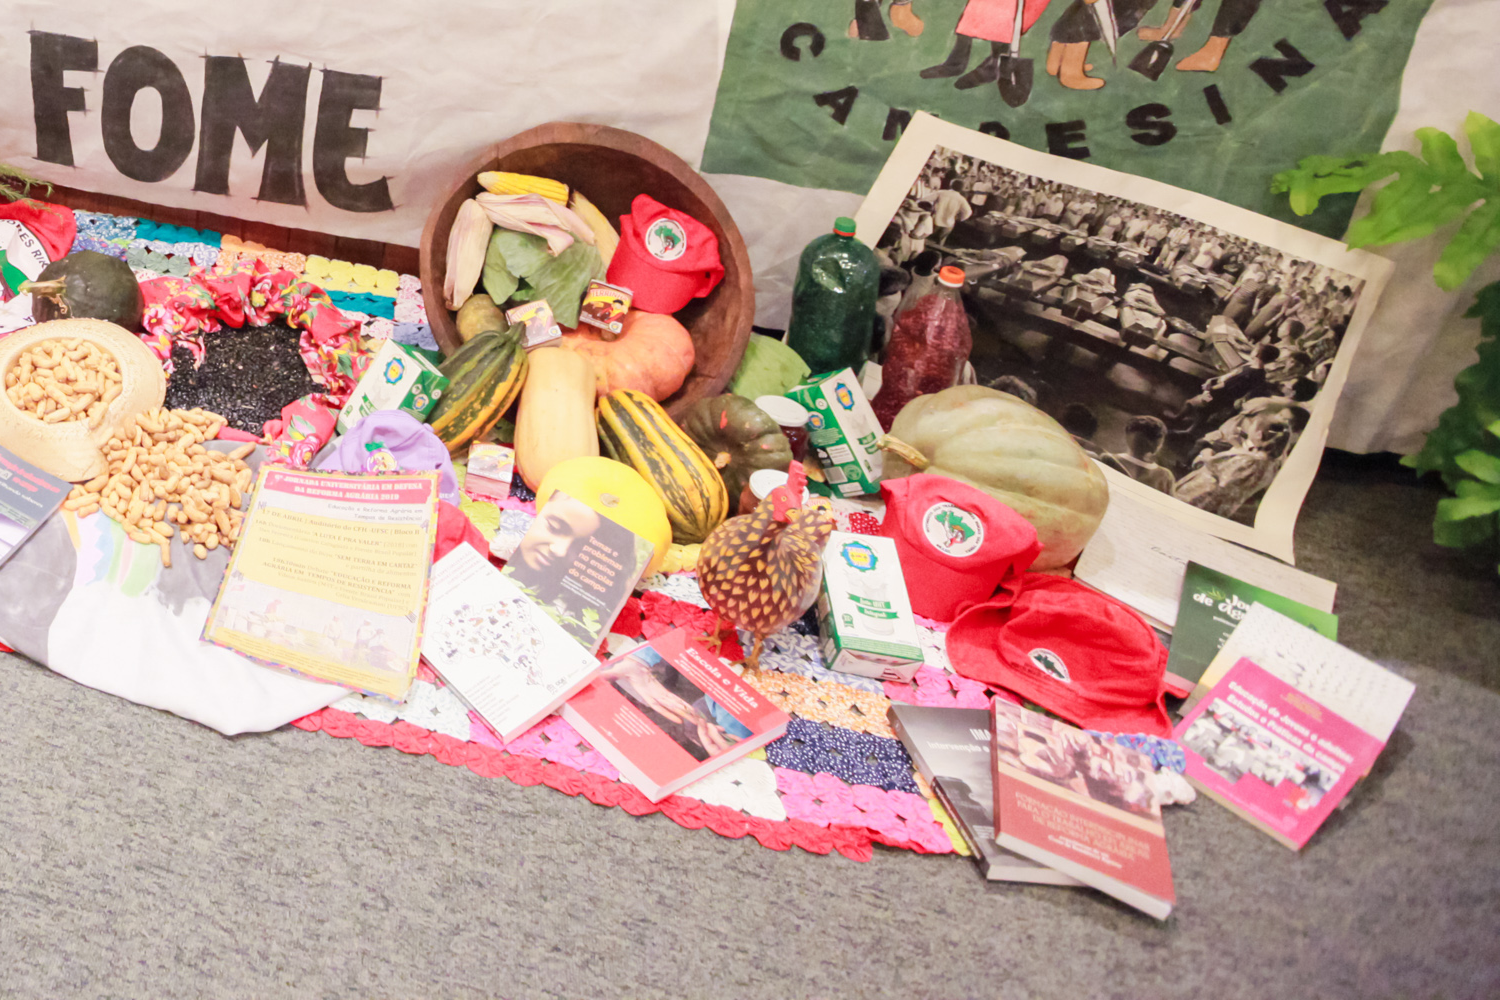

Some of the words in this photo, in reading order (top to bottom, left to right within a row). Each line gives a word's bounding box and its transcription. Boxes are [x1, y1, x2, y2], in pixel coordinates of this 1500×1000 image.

[29, 28, 396, 212] FOME
[283, 475, 320, 487] JORNADA
[321, 478, 380, 490] UNIVERSITÁRIA
[381, 482, 393, 490] EM
[293, 485, 305, 493] DA
[306, 487, 343, 498] REFORMA
[344, 490, 380, 500] AGRÁRIA
[582, 544, 623, 571] problemas
[589, 536, 612, 554] Temas
[573, 560, 586, 571] em
[586, 568, 614, 587] escolas
[578, 552, 589, 562] no
[589, 559, 615, 577] ensino
[568, 568, 580, 577] do
[580, 575, 606, 593] campo
[1192, 592, 1214, 607] de
[685, 647, 722, 679] Escola
[722, 678, 731, 686] e
[733, 684, 758, 708] Vida
[1227, 693, 1260, 720] Estudos
[1228, 681, 1268, 712] Educação
